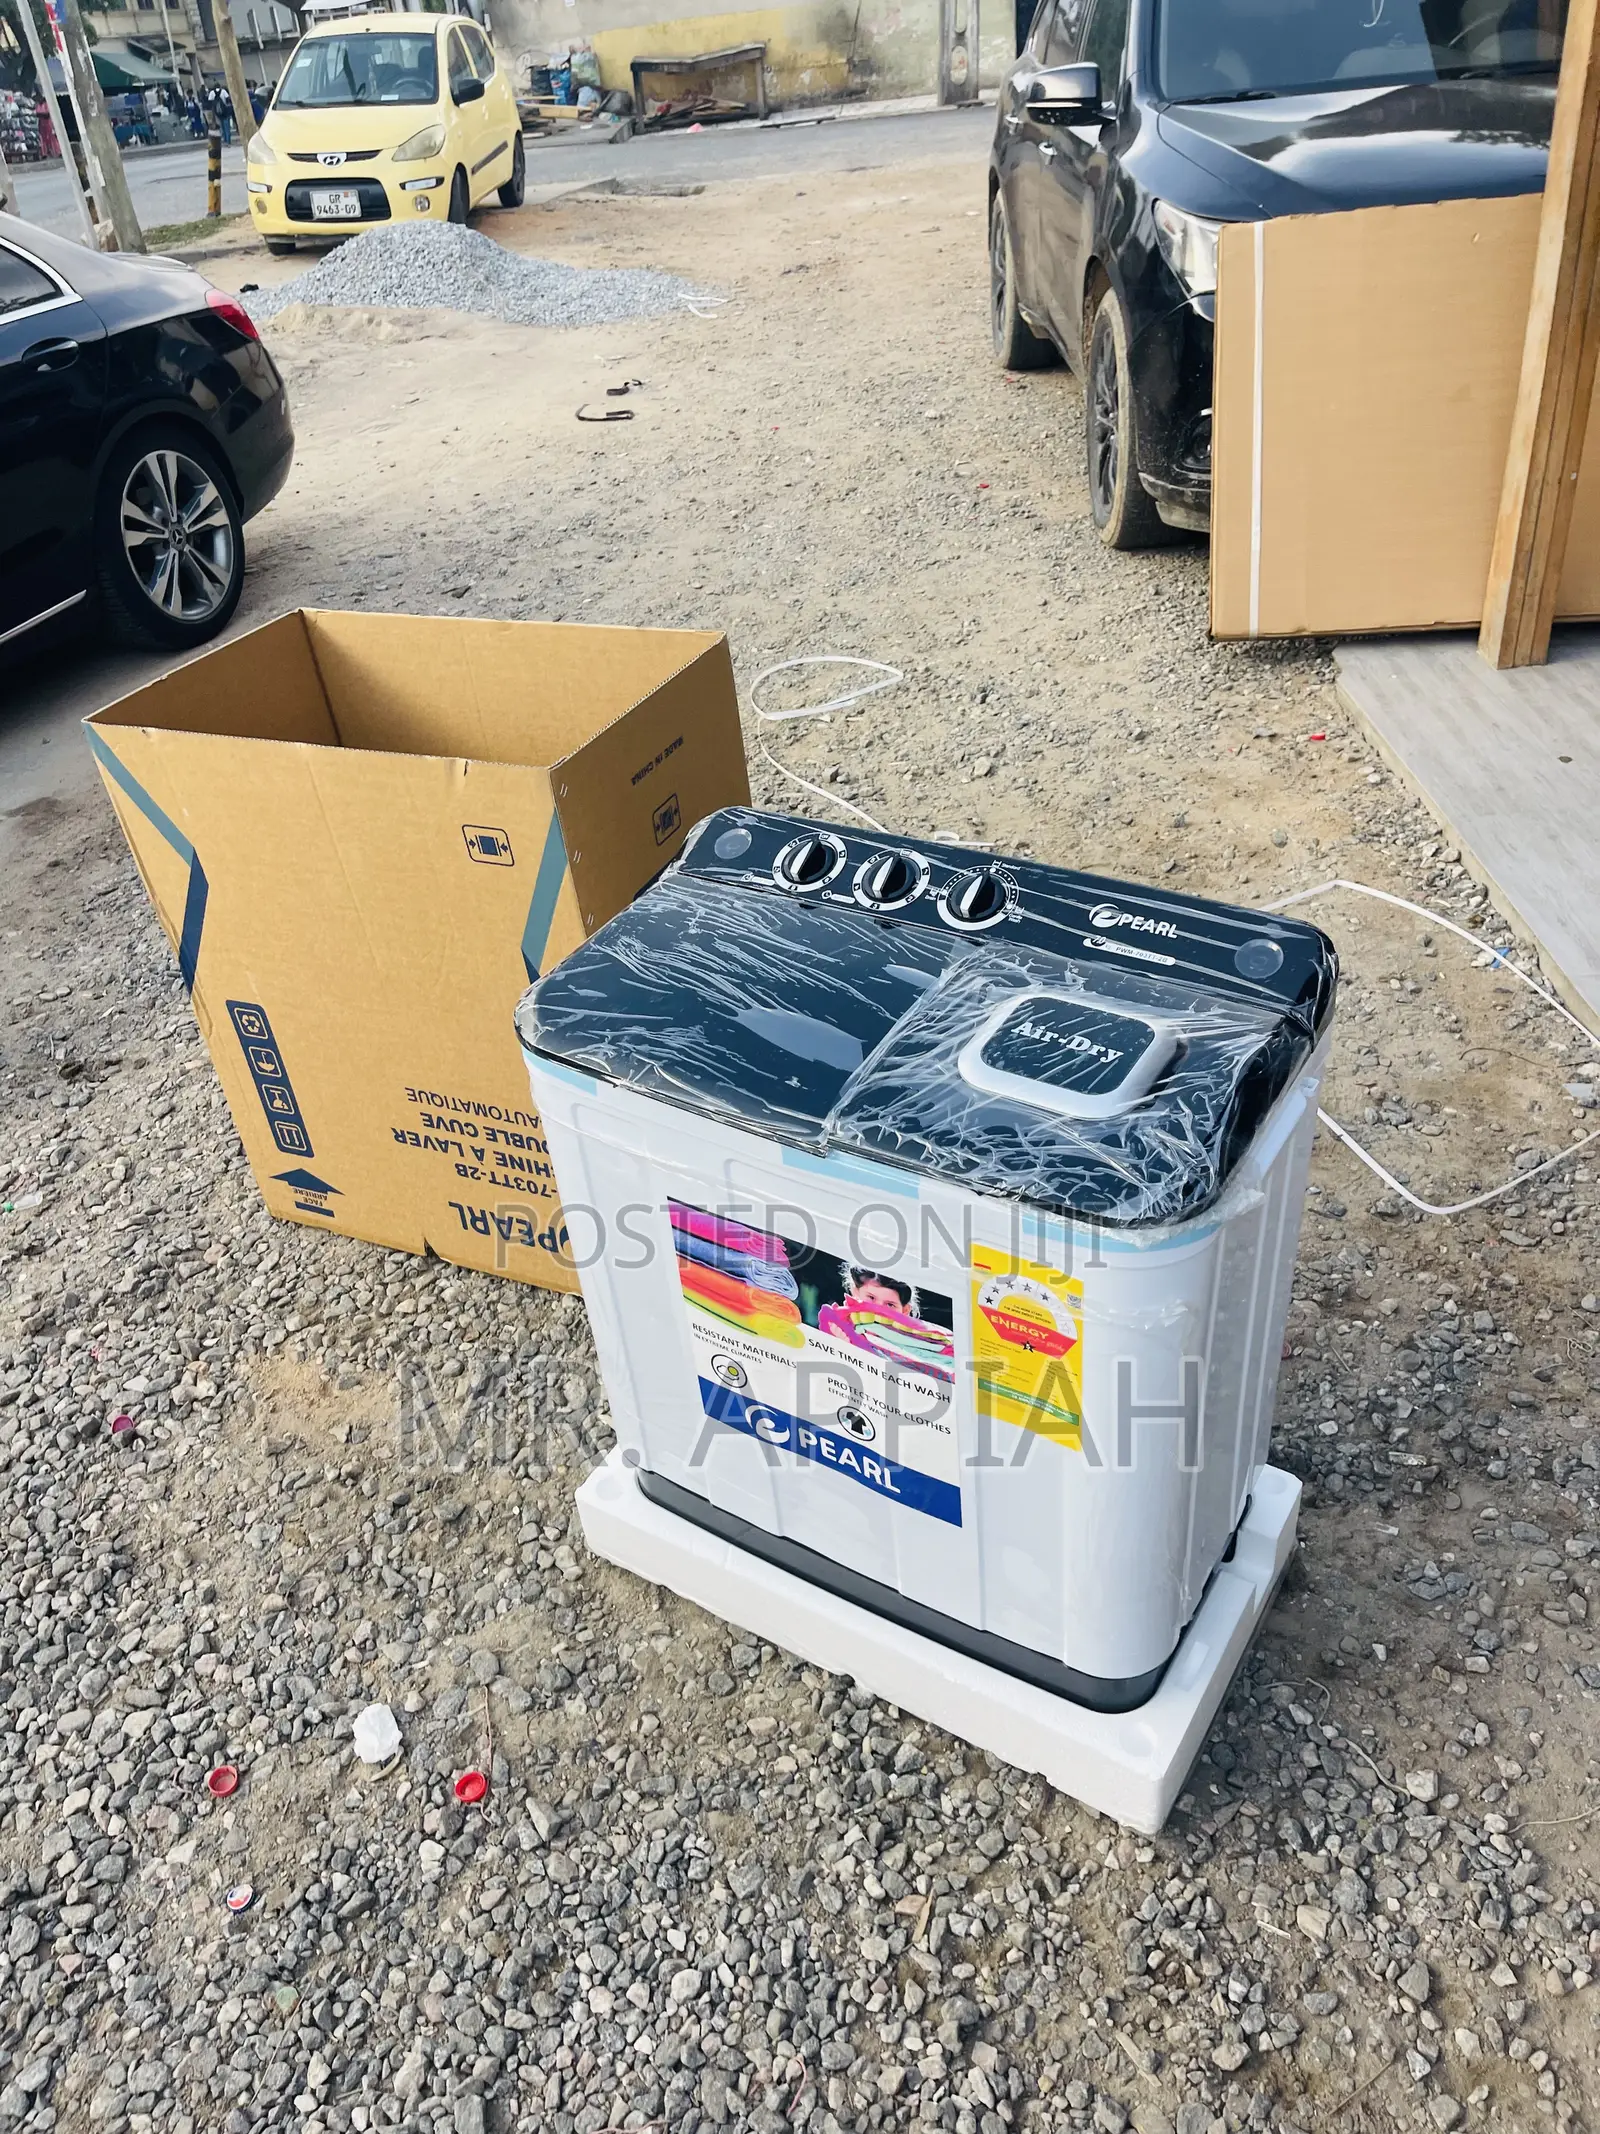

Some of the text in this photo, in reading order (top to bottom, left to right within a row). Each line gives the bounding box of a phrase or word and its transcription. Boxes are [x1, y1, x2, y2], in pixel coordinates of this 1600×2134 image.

[315, 204, 357, 216] 9463-09
[328, 193, 341, 205] GR
[631, 762, 655, 786] CHINA
[1117, 911, 1179, 940] PEARL
[1010, 1019, 1125, 1064] Air-Dry
[420, 1112, 479, 1139] CUVE
[391, 1128, 556, 1179] HINE À LAVER
[302, 1196, 323, 1207] FACE
[447, 1201, 559, 1252] PEARL
[990, 1314, 1050, 1340] ENERGY
[692, 1323, 797, 1369] RESISTANT MATERIALS
[701, 1336, 730, 1352] EXTREME
[730, 1348, 763, 1364] CLIMATES
[808, 1337, 951, 1404] SAVE TIME IN EACH WASH
[827, 1376, 951, 1435] PROTECT YOUR CLOTHES
[797, 1426, 901, 1494] PEARL
